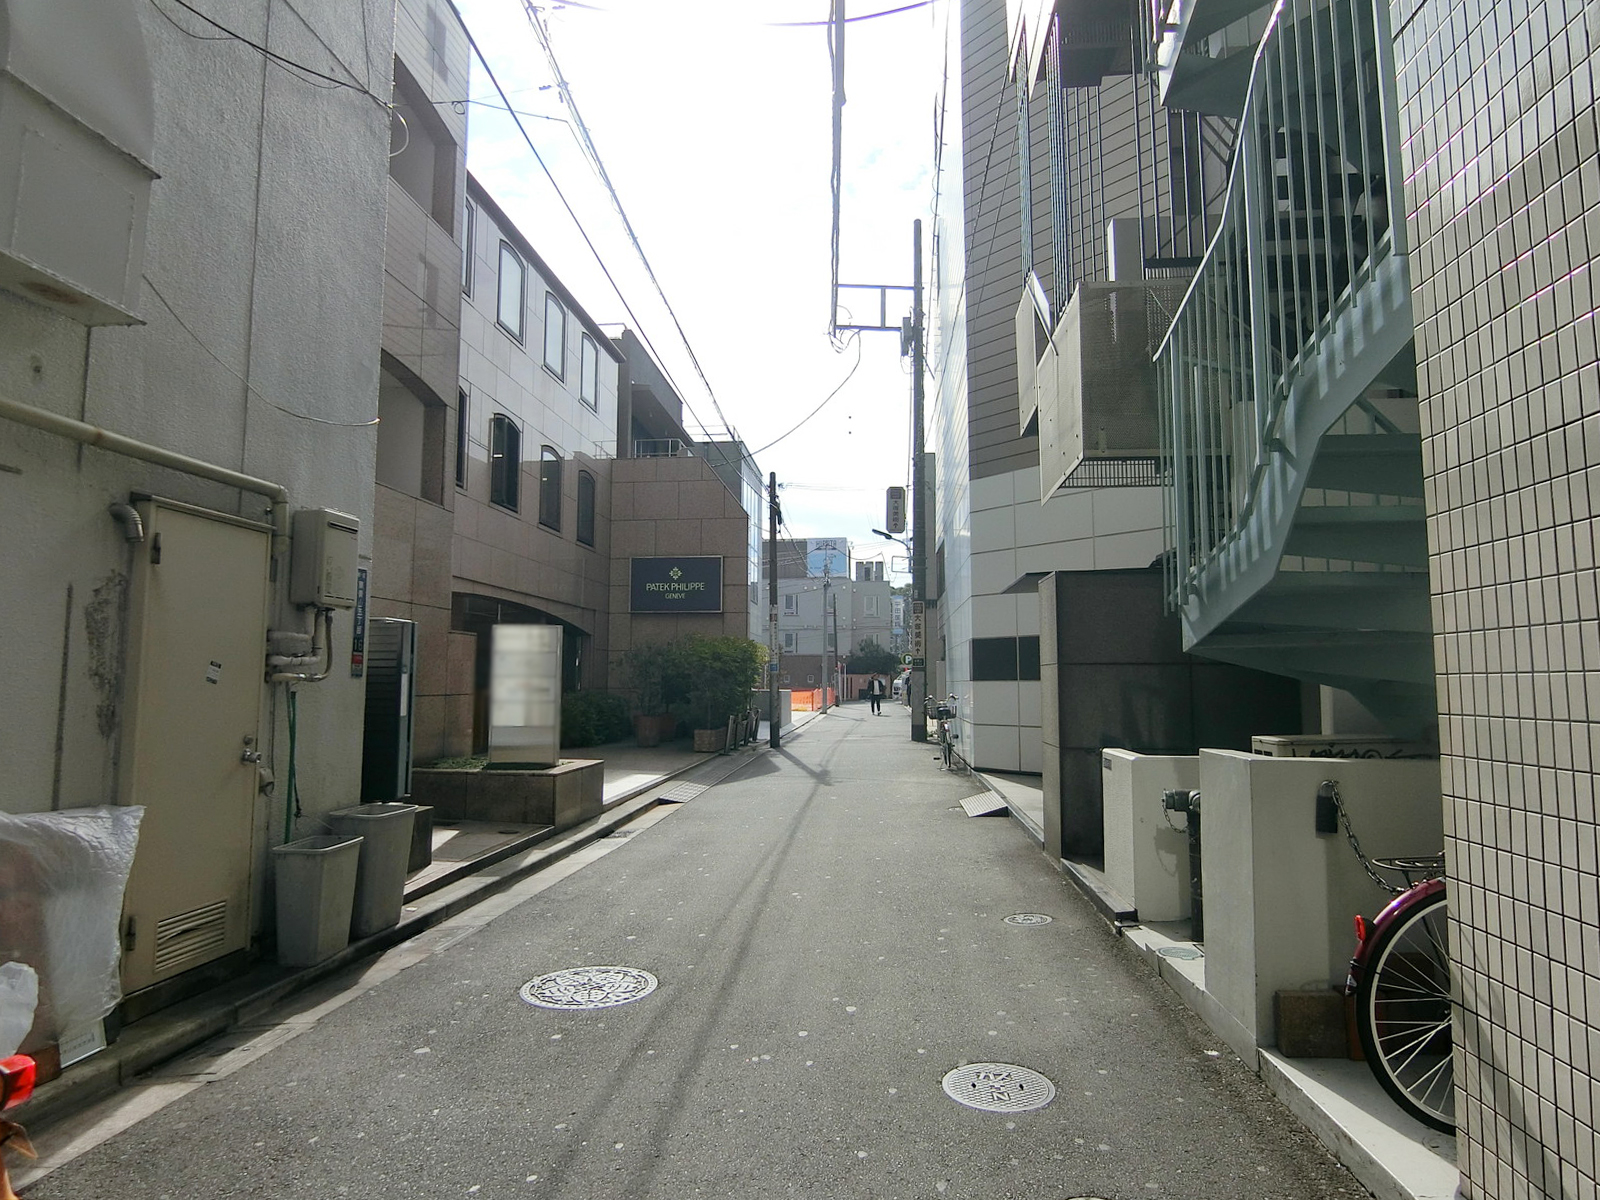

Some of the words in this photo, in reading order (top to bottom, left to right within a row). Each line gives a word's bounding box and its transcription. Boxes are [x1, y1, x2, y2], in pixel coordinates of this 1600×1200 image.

[646, 582, 670, 591] PATEK
[671, 582, 705, 591] PHILIPPE
[905, 655, 912, 664] P
